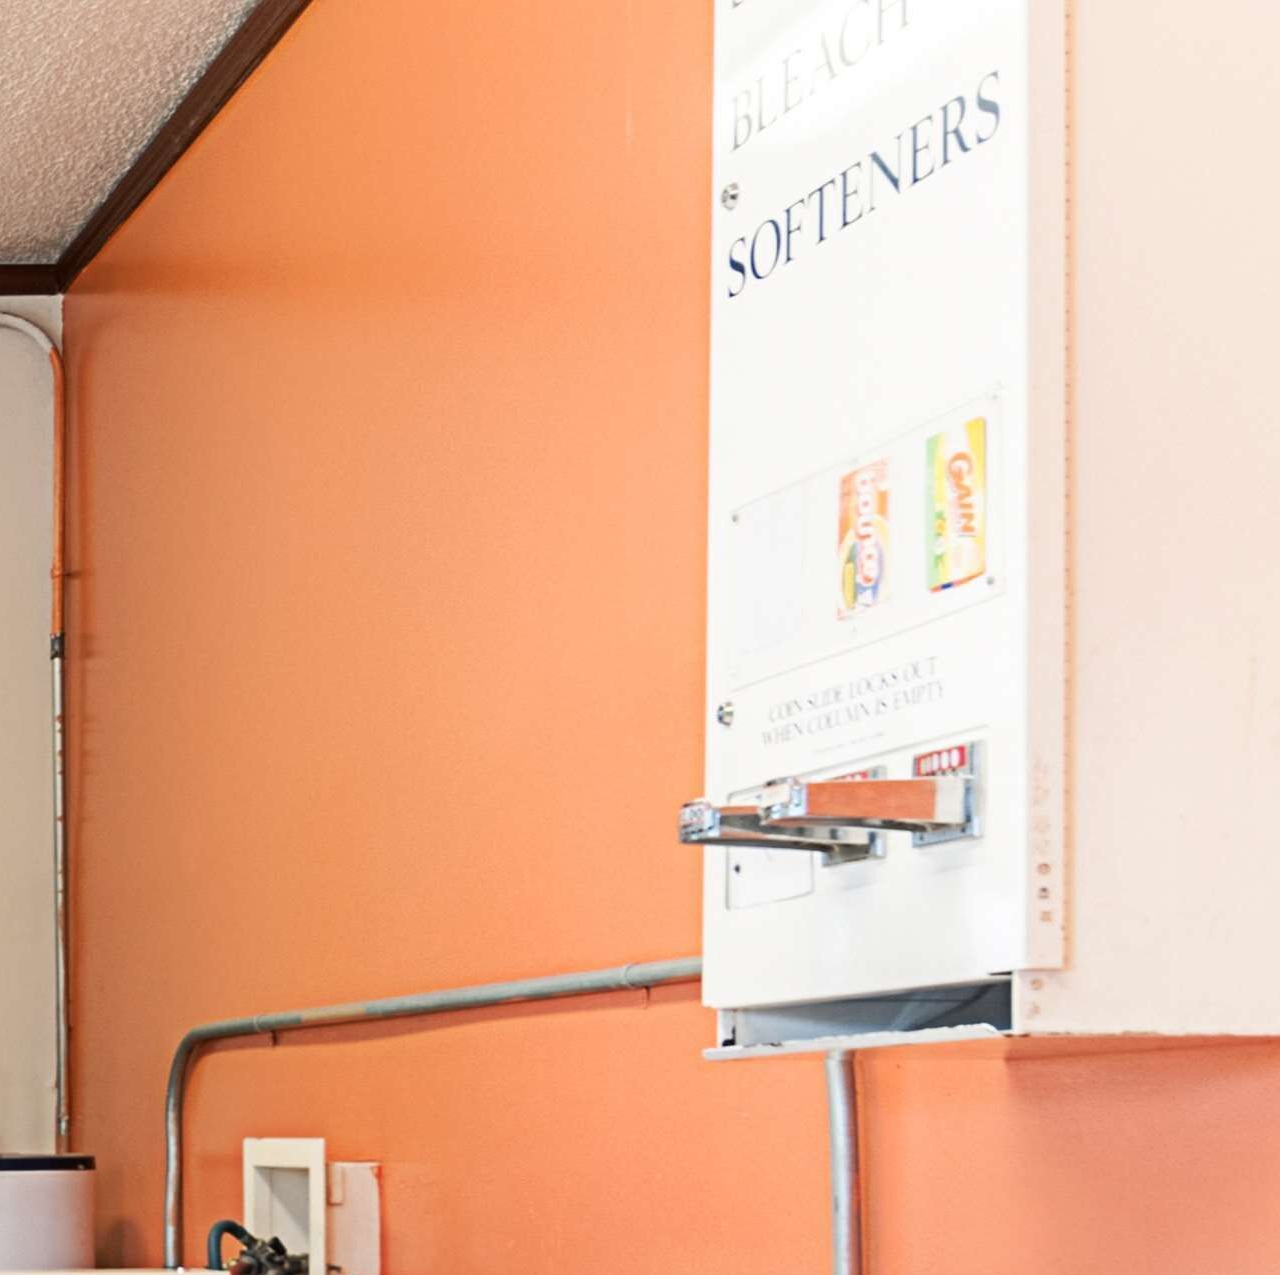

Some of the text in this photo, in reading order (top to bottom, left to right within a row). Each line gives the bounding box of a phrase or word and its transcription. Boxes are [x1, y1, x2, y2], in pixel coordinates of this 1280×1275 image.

[729, 0, 914, 152] BLEACH
[727, 70, 1002, 299] SOFTENERS
[761, 721, 804, 746] WHEN
[874, 697, 889, 717] IS
[892, 679, 945, 712] EMPTY
[768, 655, 938, 725] COIN SLIDE LOCKS OUT
